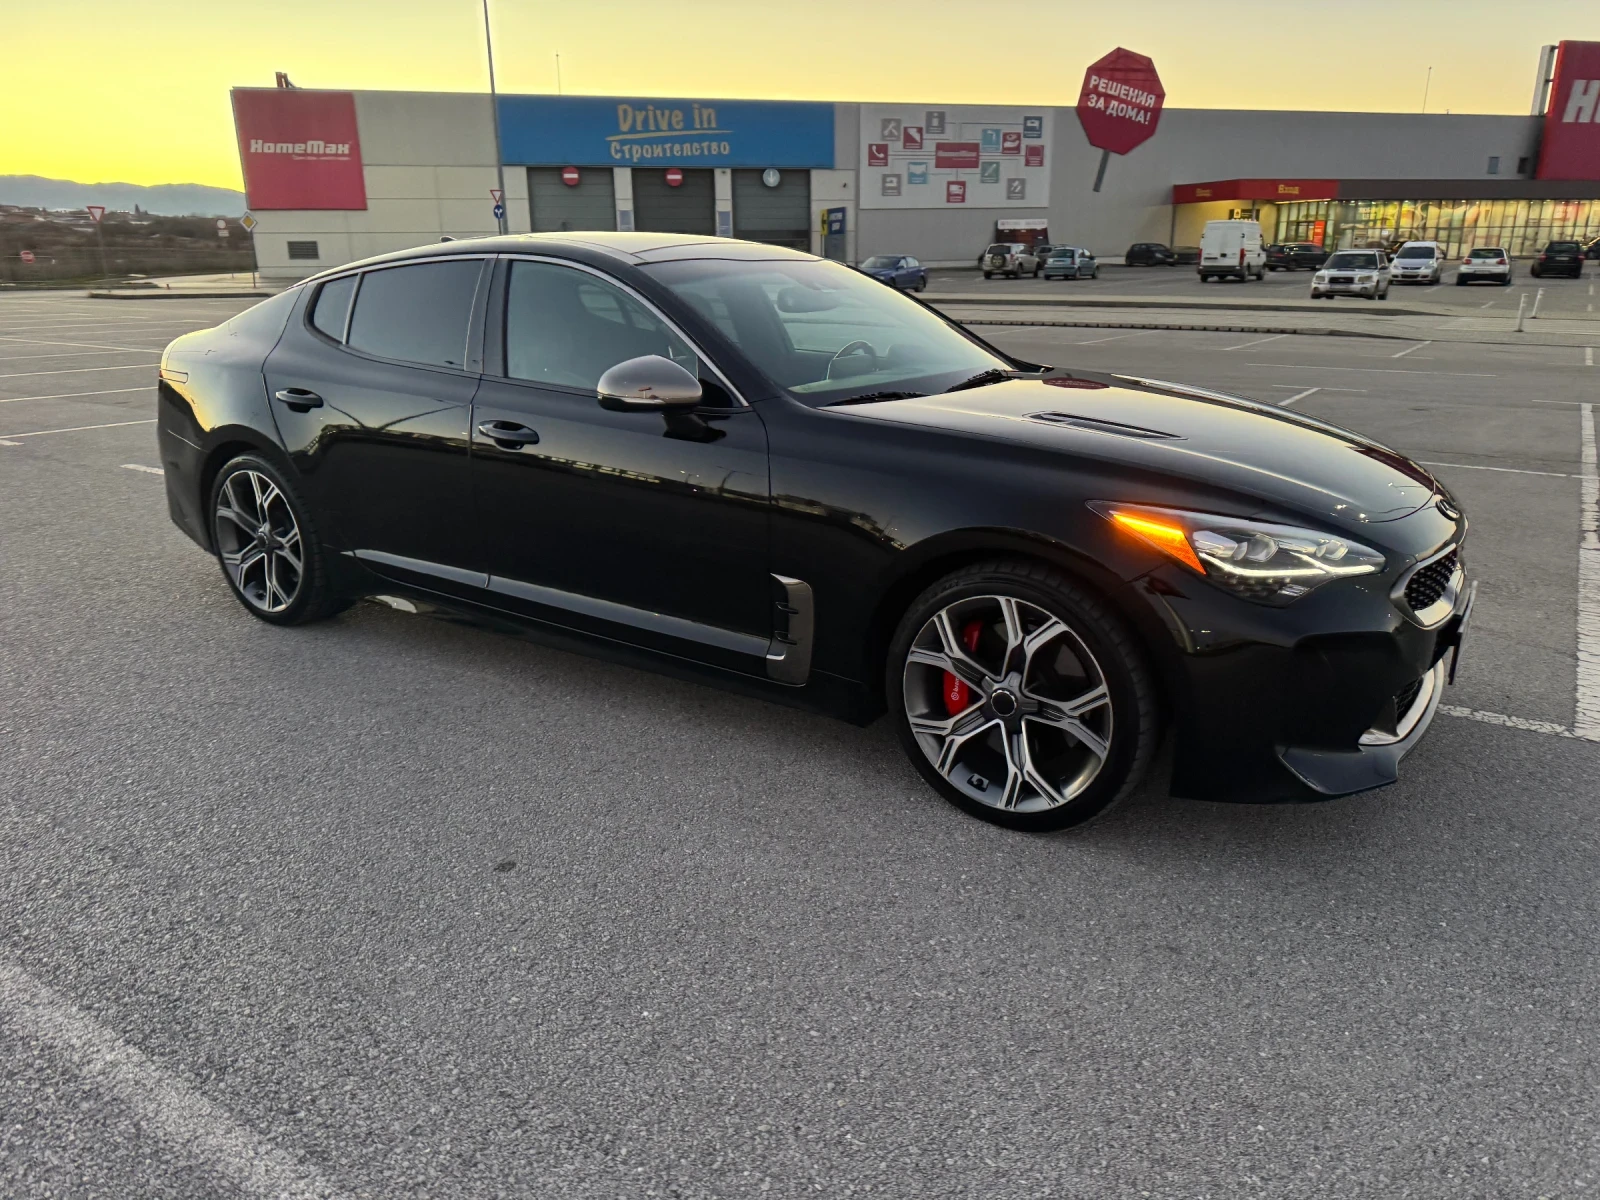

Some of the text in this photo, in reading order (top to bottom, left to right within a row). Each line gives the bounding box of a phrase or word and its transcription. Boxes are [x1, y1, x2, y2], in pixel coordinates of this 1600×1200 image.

[1089, 75, 1156, 108] РЕШЕНИЯ
[617, 102, 717, 132] Drive in
[1087, 94, 1151, 125] ЗА ДОМА!
[250, 139, 350, 154] HomeMax
[610, 141, 730, 162] Строителство
